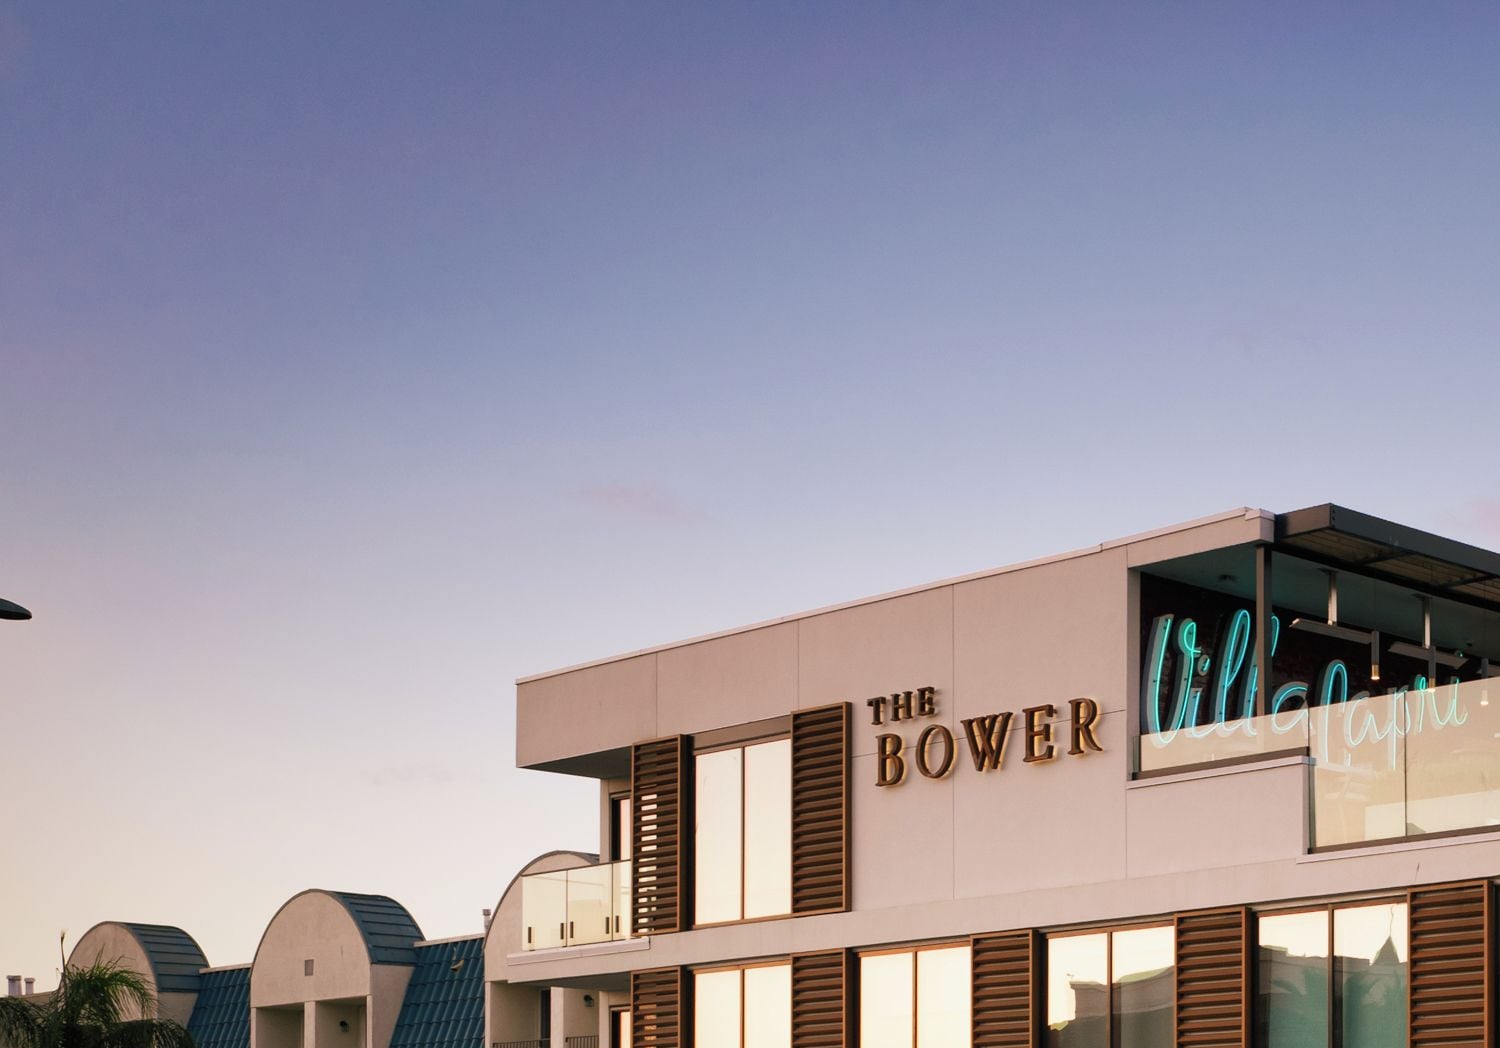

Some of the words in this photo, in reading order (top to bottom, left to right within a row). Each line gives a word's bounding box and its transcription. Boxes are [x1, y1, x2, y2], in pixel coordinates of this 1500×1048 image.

[867, 686, 937, 726] THE
[1146, 609, 1316, 748] Villa
[1320, 659, 1468, 771] Capri
[874, 698, 1103, 787] BOWER
